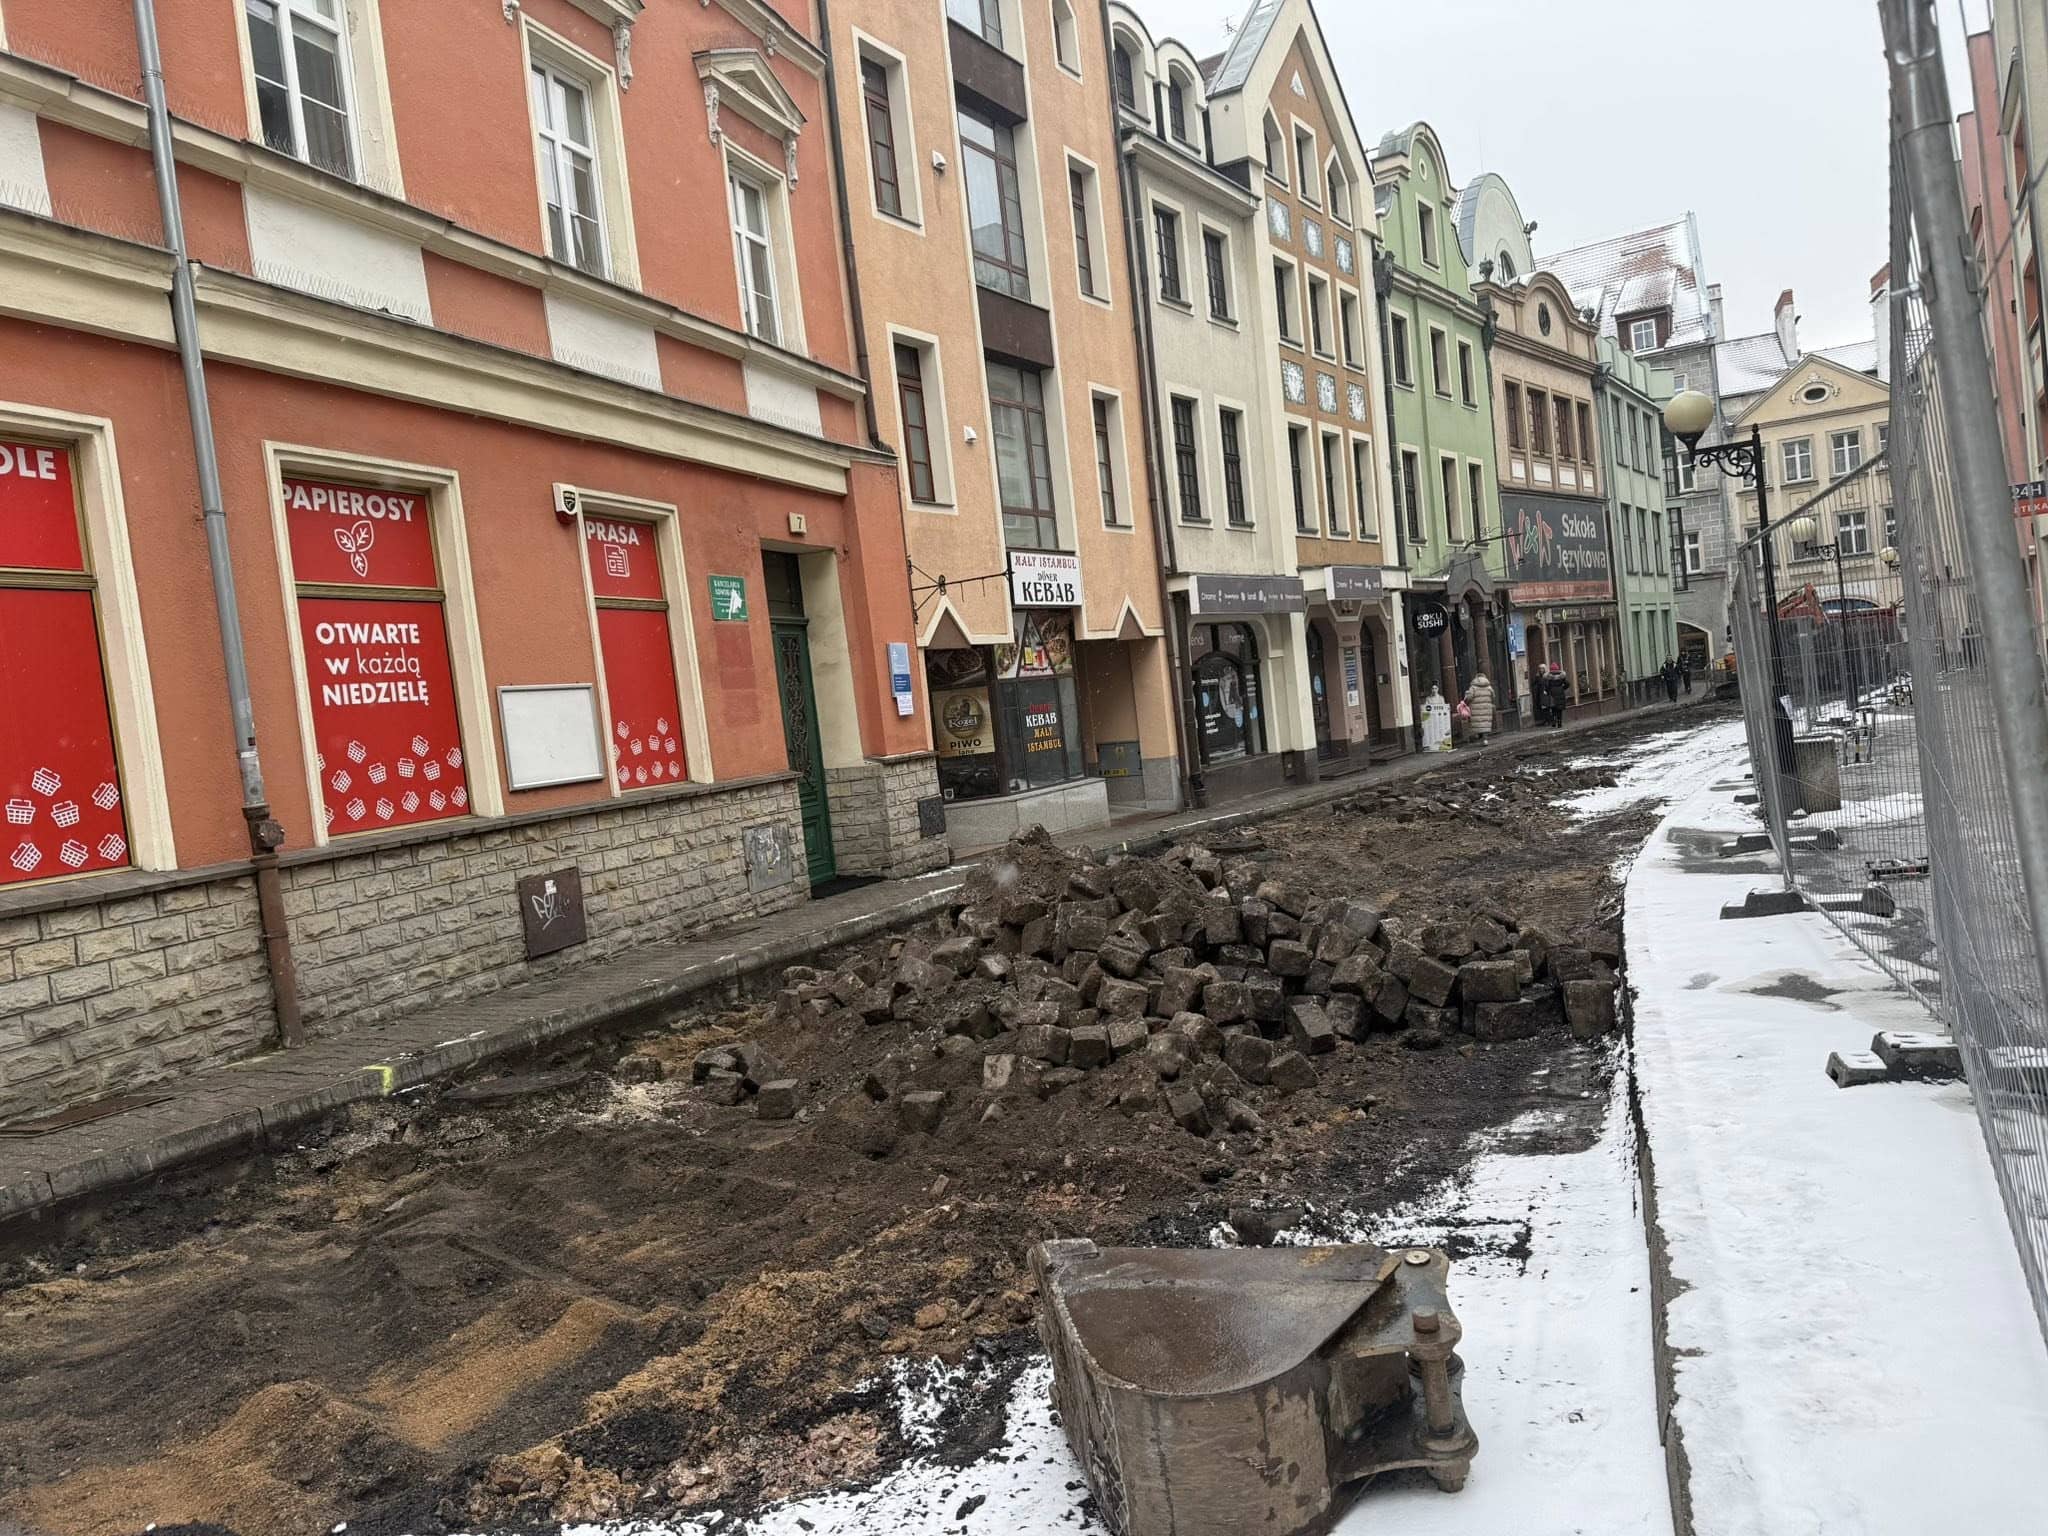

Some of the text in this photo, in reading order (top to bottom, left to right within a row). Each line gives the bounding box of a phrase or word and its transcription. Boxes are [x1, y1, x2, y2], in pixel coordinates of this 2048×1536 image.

[282, 484, 414, 522] PAPIEROSY
[585, 521, 640, 546] PRASA
[1561, 513, 1597, 539] Szkoła
[1556, 544, 1607, 575] Językowa
[1022, 581, 1075, 603] KEBAB
[315, 622, 421, 645] OTWARTE
[1417, 619, 1444, 630] SUSHI
[324, 647, 421, 678] w każdą
[322, 680, 430, 706] NIEDZIELĘ
[948, 716, 978, 729] Kozel
[1025, 712, 1057, 728] KEBAB
